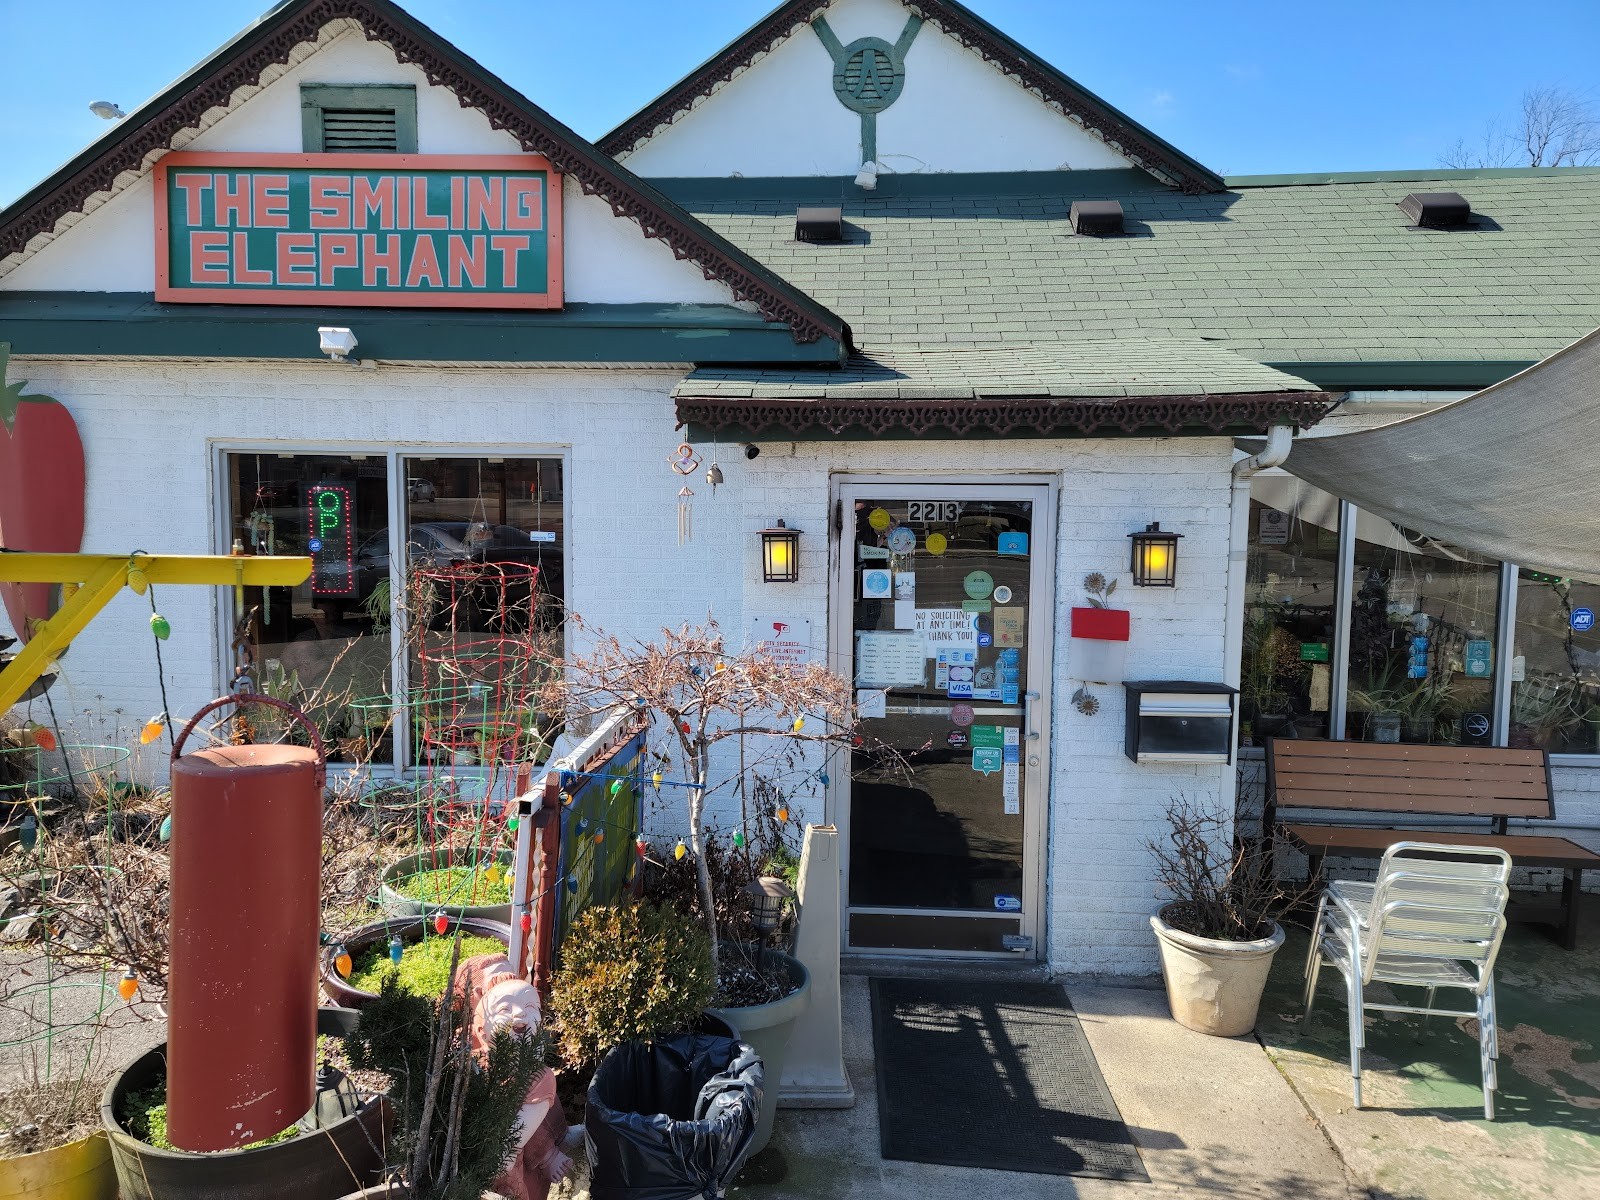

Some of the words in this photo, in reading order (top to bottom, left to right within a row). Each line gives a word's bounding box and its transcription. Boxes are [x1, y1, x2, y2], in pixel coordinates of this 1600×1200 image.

[175, 173, 290, 229] THE
[308, 175, 543, 231] SMILING
[189, 231, 530, 288] ELEPHANT
[909, 502, 958, 521] 2213
[915, 612, 926, 620] NO
[931, 611, 971, 620] SOLICITING
[1574, 615, 1590, 624] ADT
[916, 620, 925, 629] AT
[930, 620, 945, 629] ANY
[949, 620, 970, 629] TIME!
[929, 631, 953, 641] THANK
[957, 630, 973, 643] YOU!
